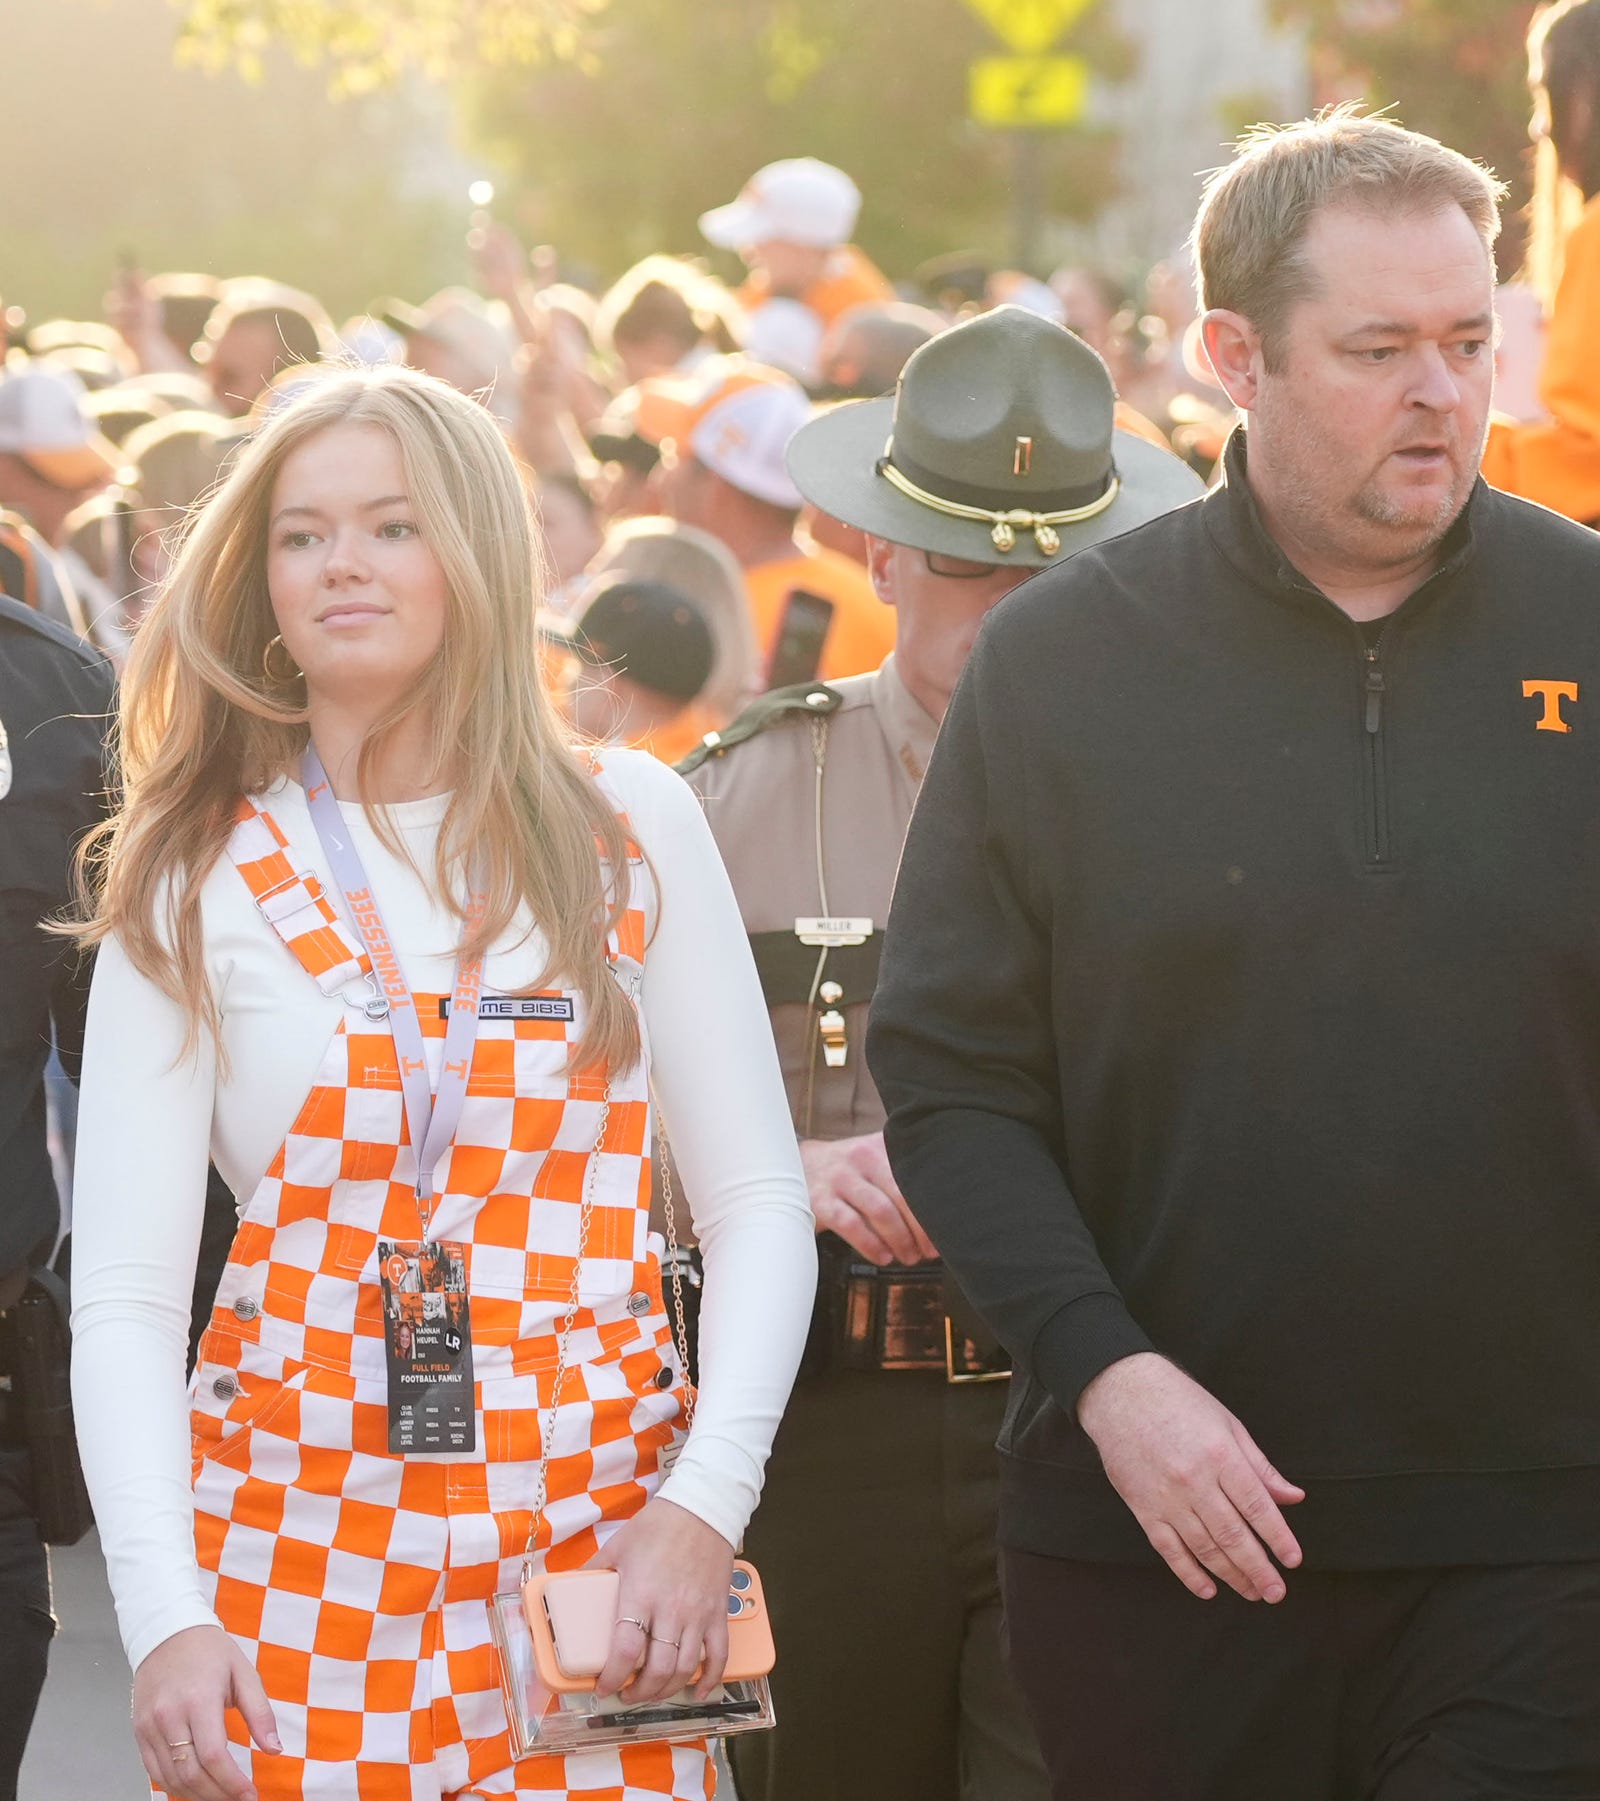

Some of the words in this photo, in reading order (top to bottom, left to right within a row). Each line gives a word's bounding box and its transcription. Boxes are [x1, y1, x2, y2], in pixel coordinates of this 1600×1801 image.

[1522, 680, 1578, 733] T
[345, 887, 411, 1012] TENNESSEE
[480, 1003, 513, 1013] ME
[521, 1003, 567, 1014] BIBS
[415, 1327, 441, 1335] HANNAH
[445, 1333, 461, 1351] LR
[412, 1363, 429, 1372] FULL
[430, 1363, 450, 1372] FIELD
[400, 1374, 437, 1384] FOOTBALL
[438, 1374, 463, 1383] FAMILY
